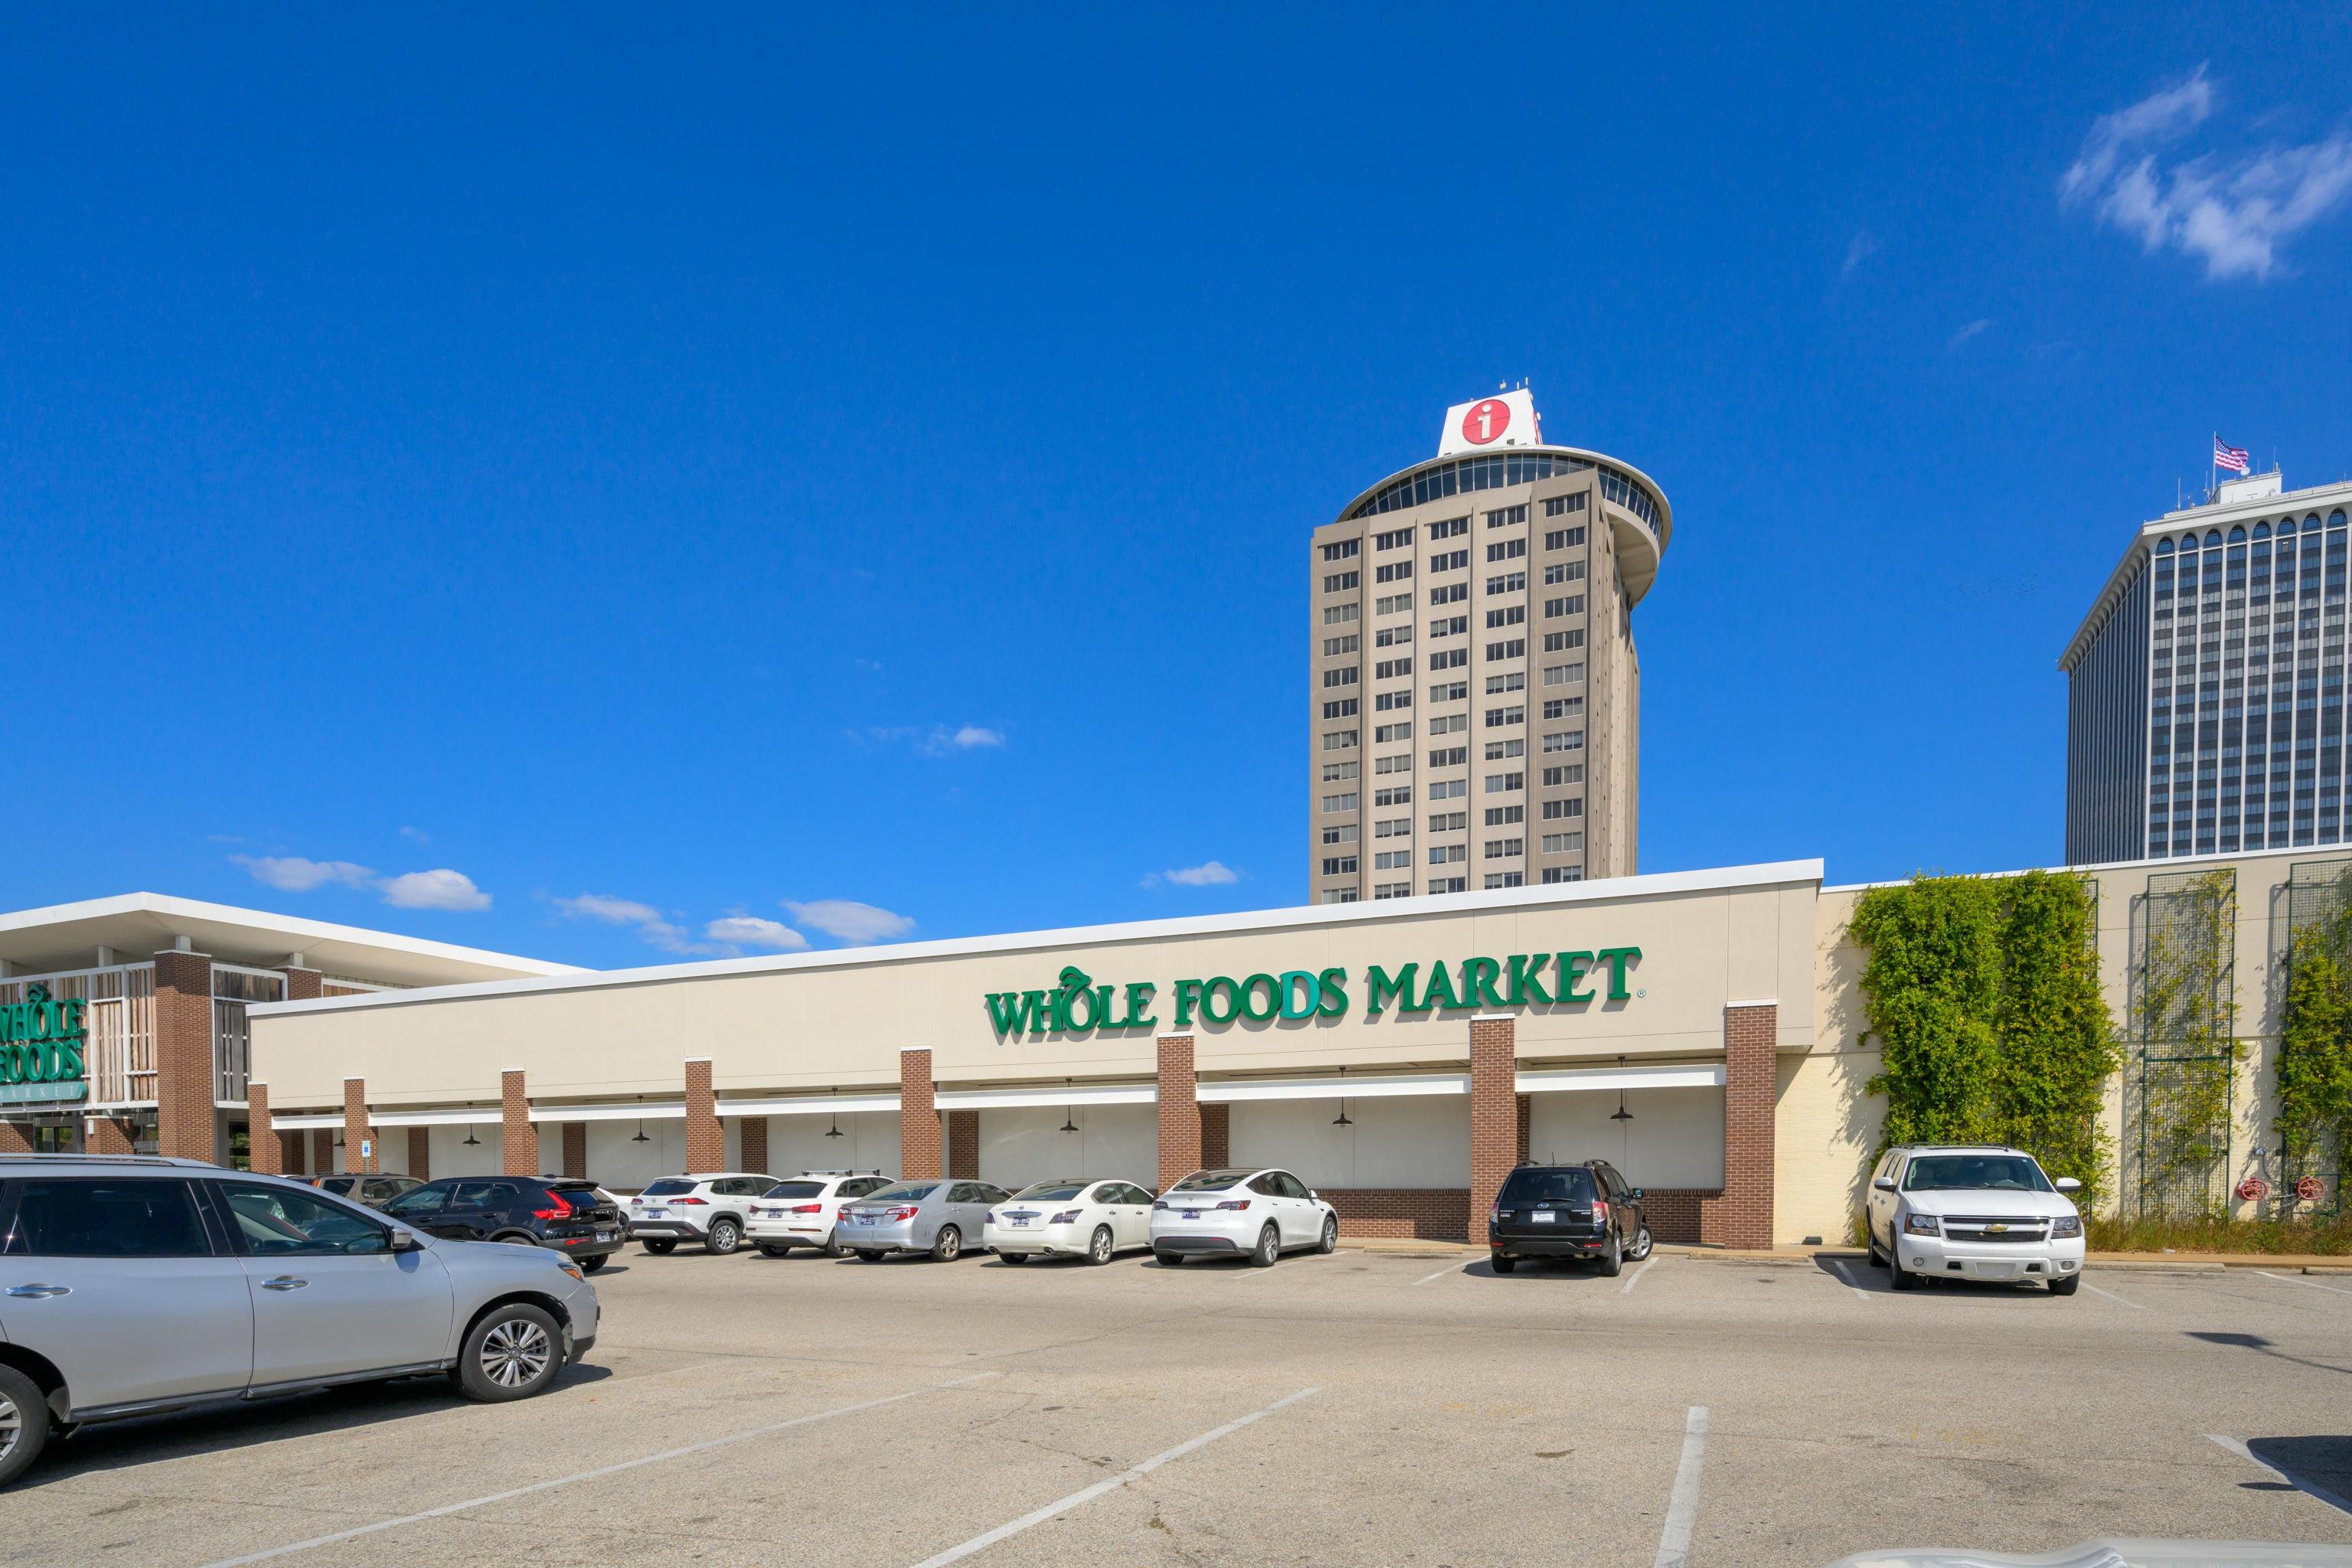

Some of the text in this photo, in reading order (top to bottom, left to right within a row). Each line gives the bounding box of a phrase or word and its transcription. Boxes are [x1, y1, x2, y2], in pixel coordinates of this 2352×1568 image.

[1478, 404, 1492, 440] i
[985, 965, 1158, 1034] WHOLE
[1174, 967, 1350, 1024] FOODS
[1367, 946, 1642, 1013] MARKET
[0, 1086, 75, 1101] ARKET
